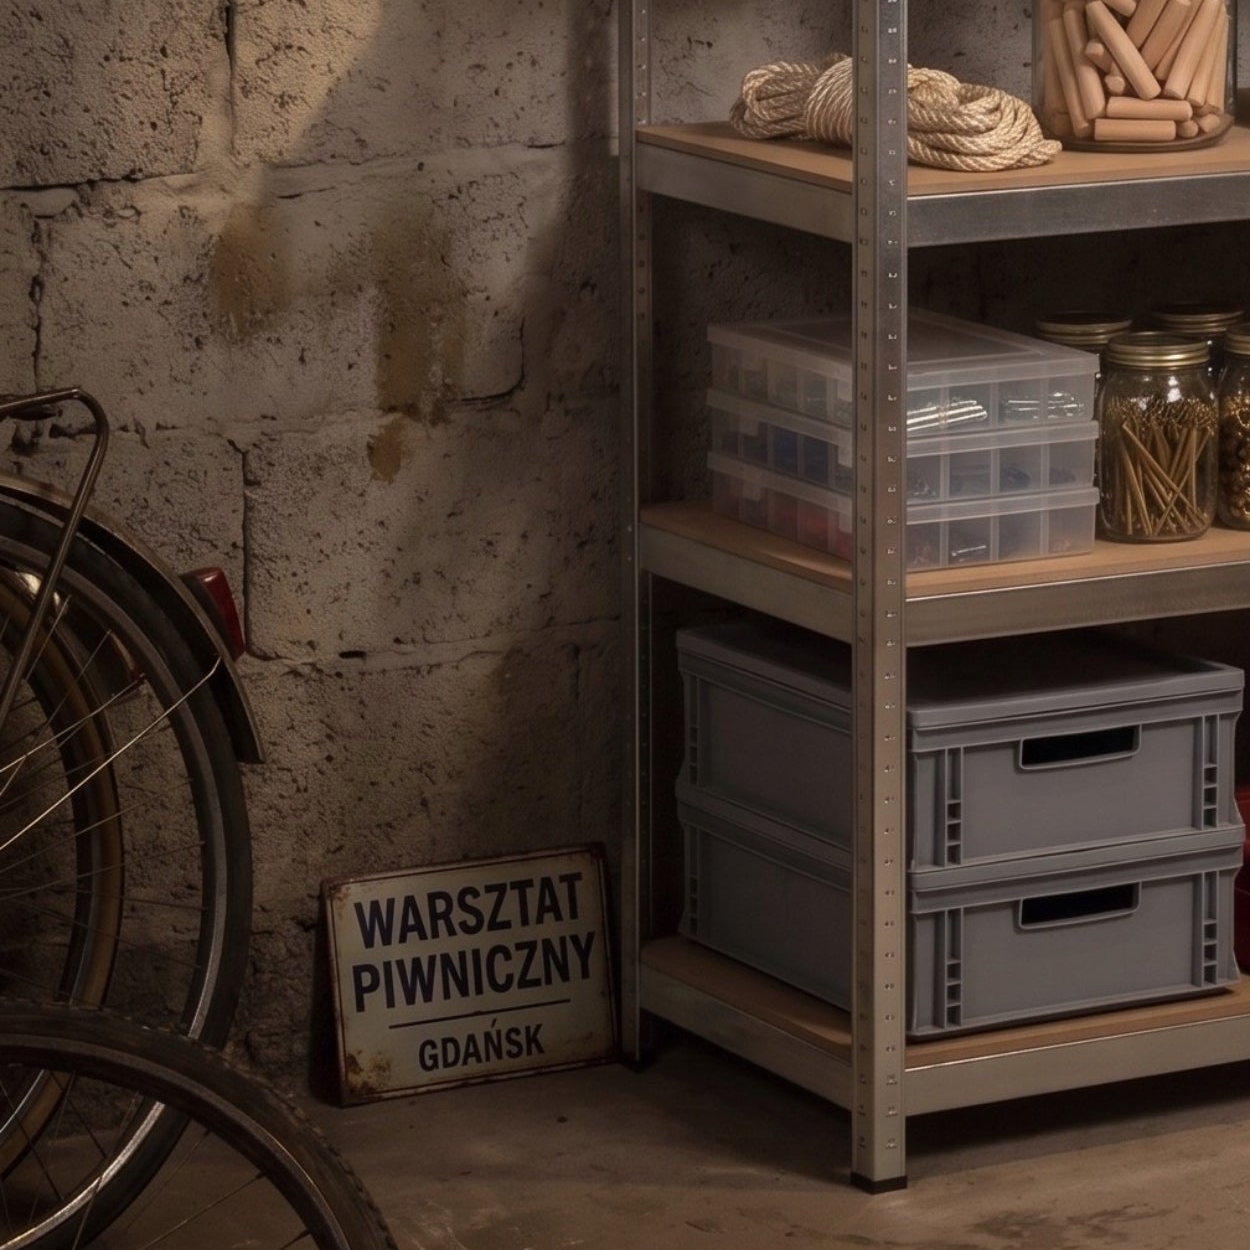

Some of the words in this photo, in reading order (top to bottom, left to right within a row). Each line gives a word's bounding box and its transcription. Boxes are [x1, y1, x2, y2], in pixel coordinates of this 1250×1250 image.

[354, 872, 582, 949] WARSZTAT
[352, 931, 596, 1013] PIWNICZNY
[418, 1018, 545, 1072] GDAŃSK
